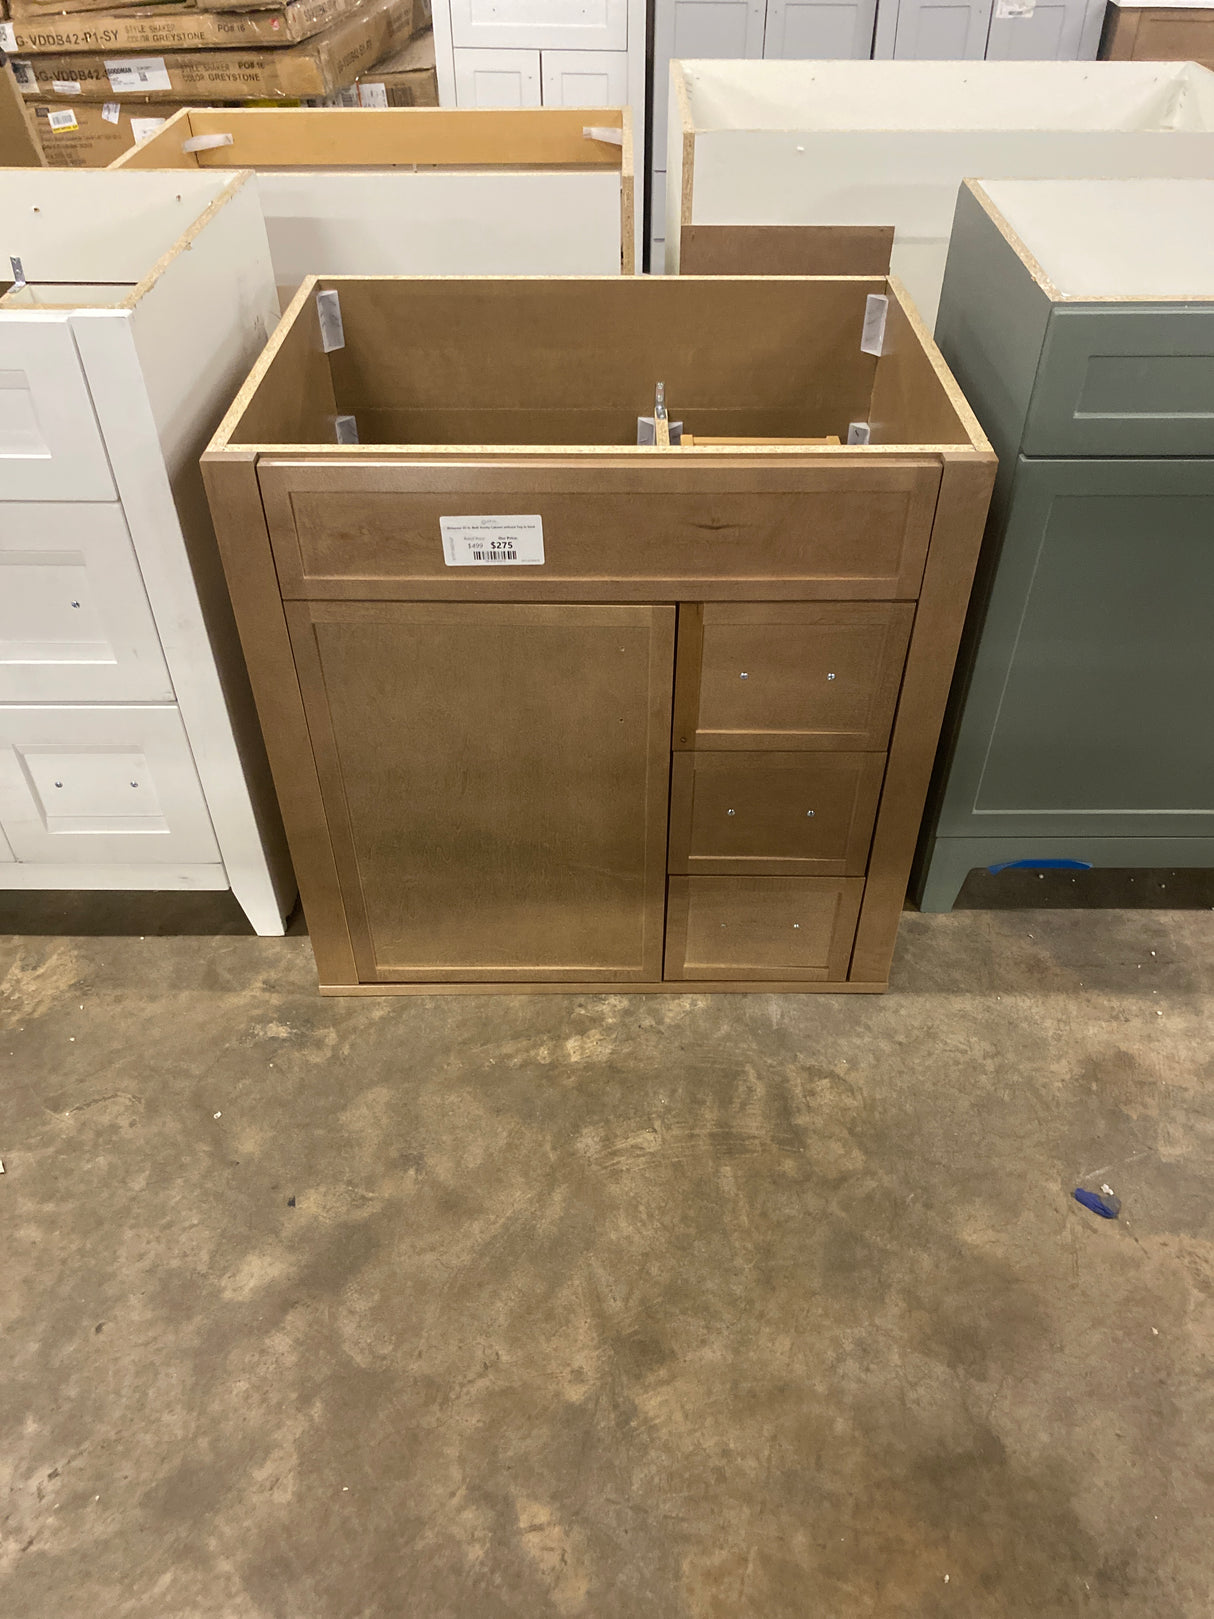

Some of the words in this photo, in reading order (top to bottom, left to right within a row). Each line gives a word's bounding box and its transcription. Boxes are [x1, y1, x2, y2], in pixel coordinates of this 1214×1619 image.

[152, 31, 206, 42] GREYSTONE
[208, 73, 261, 82] GREYSTONE
[490, 541, 513, 550] $275
